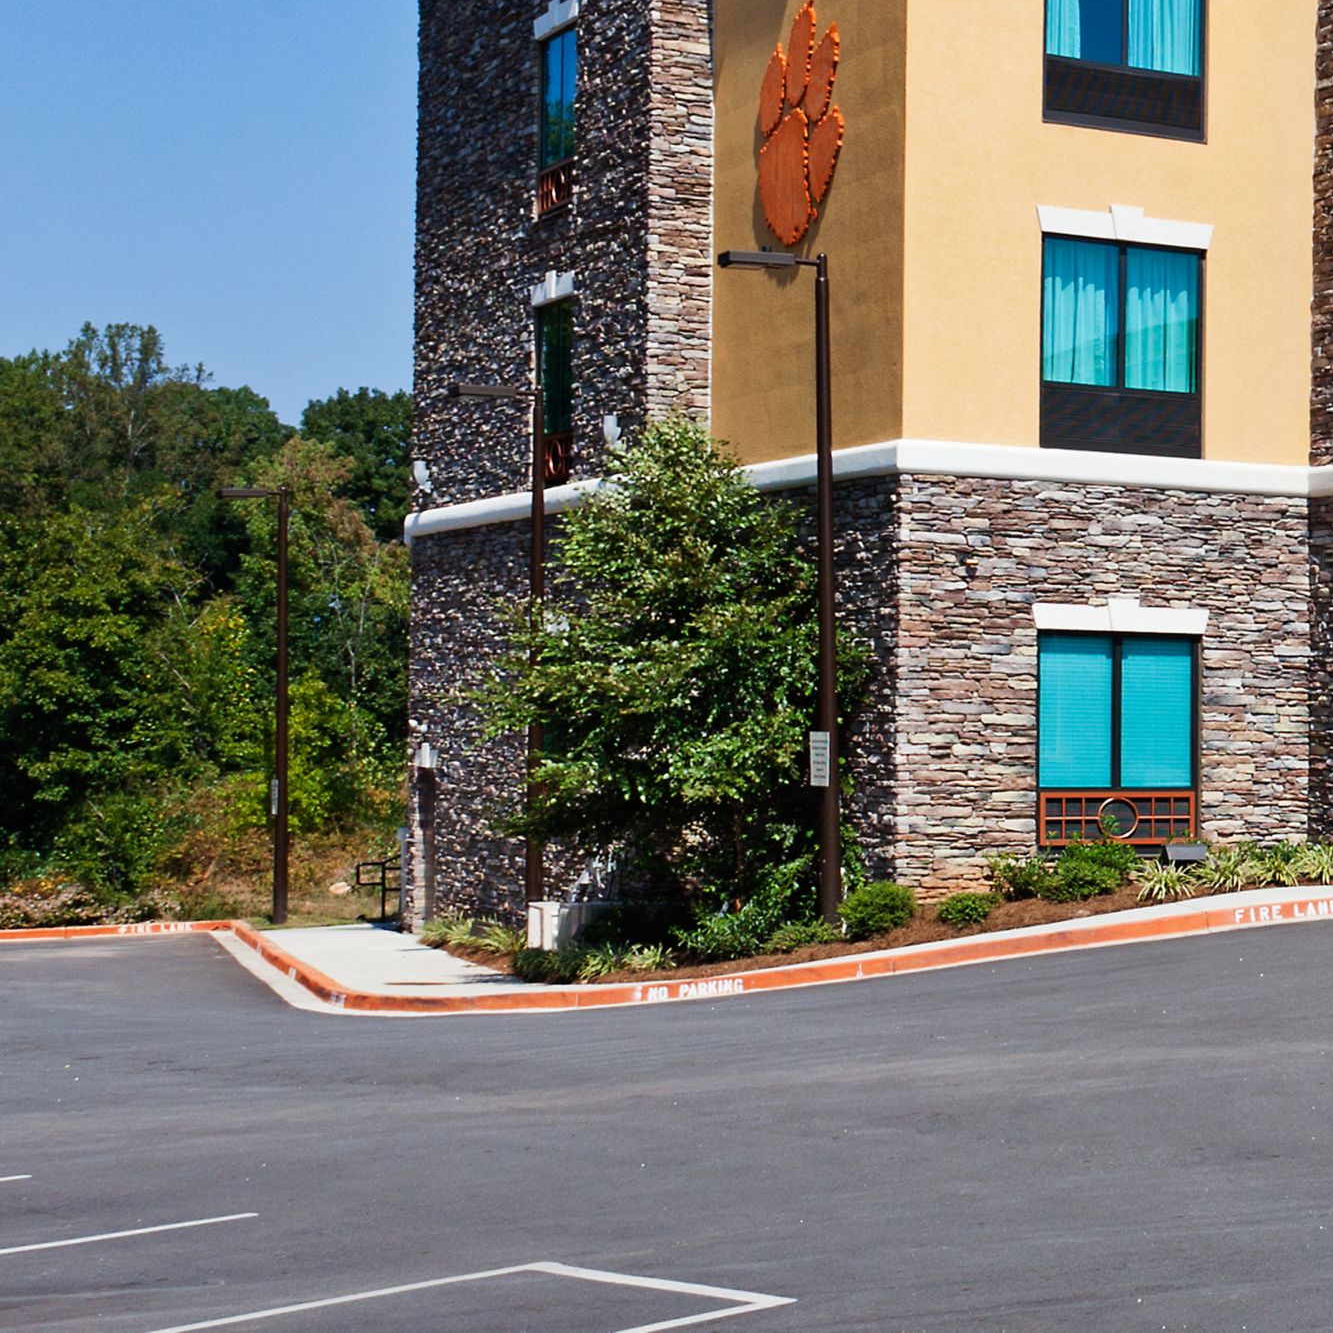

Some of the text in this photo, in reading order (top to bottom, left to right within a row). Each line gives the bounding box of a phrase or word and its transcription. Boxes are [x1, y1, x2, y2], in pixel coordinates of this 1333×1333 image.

[1234, 904, 1283, 924] FIRE
[647, 978, 744, 1003] NO PARKING
